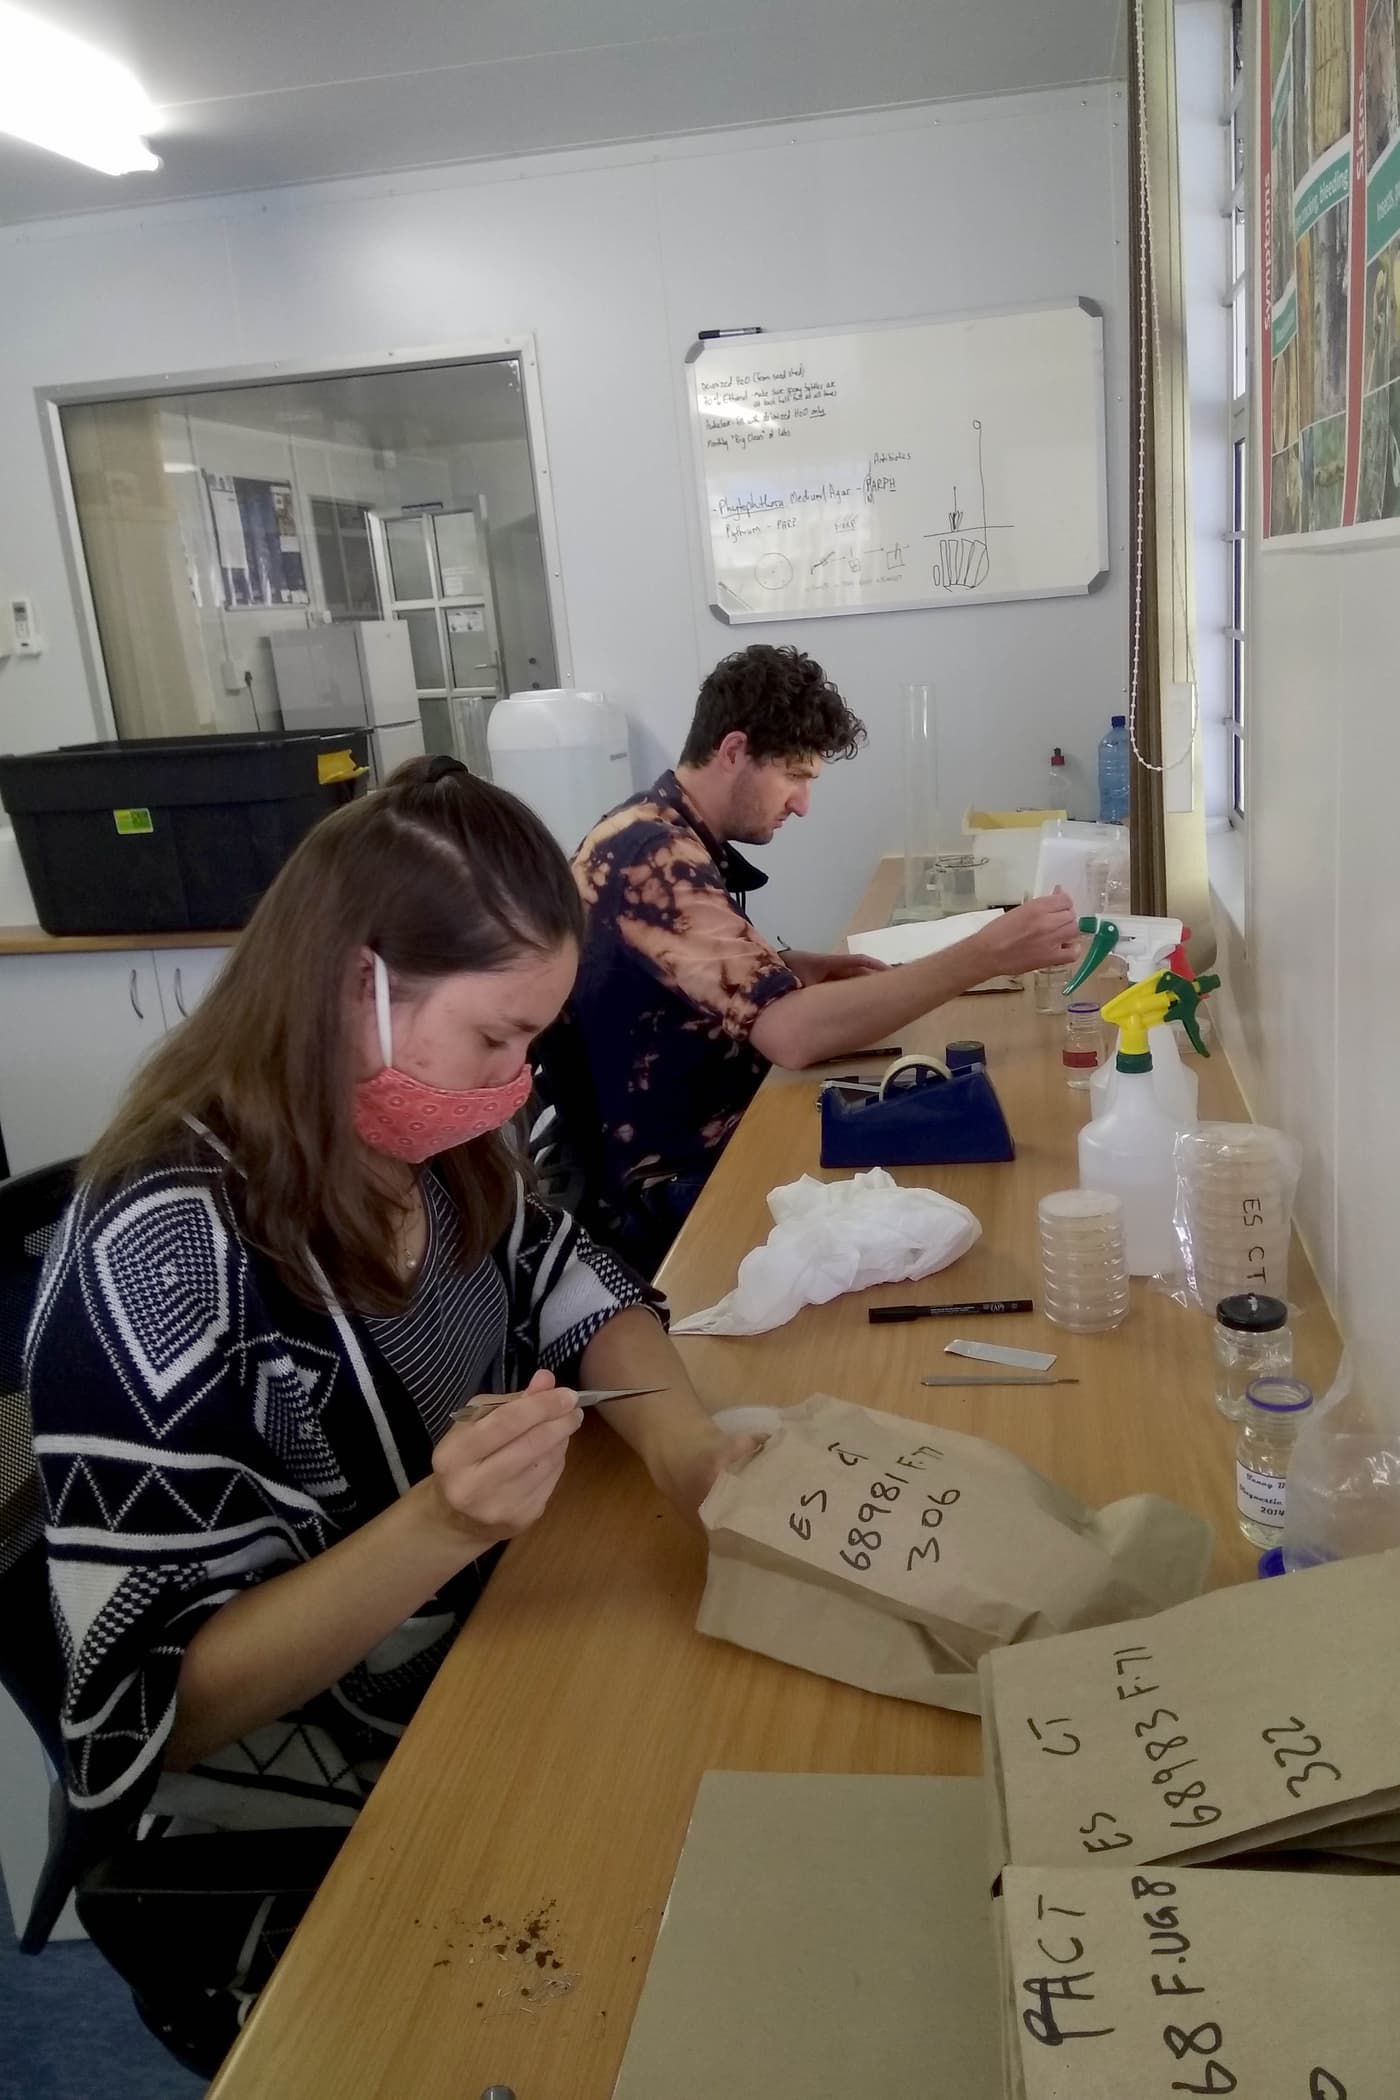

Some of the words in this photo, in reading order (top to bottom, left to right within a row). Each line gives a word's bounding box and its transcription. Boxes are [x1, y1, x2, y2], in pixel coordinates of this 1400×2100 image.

[1356, 72, 1365, 180] Signs
[1263, 172, 1272, 331] Symptoms
[1243, 1198, 1263, 1227] ES
[790, 1489, 828, 1541] ES
[906, 1489, 961, 1572] 306
[1135, 1708, 1222, 1828] 68983
[1262, 1716, 1341, 1798] 322
[1079, 1812, 1133, 1853] ES
